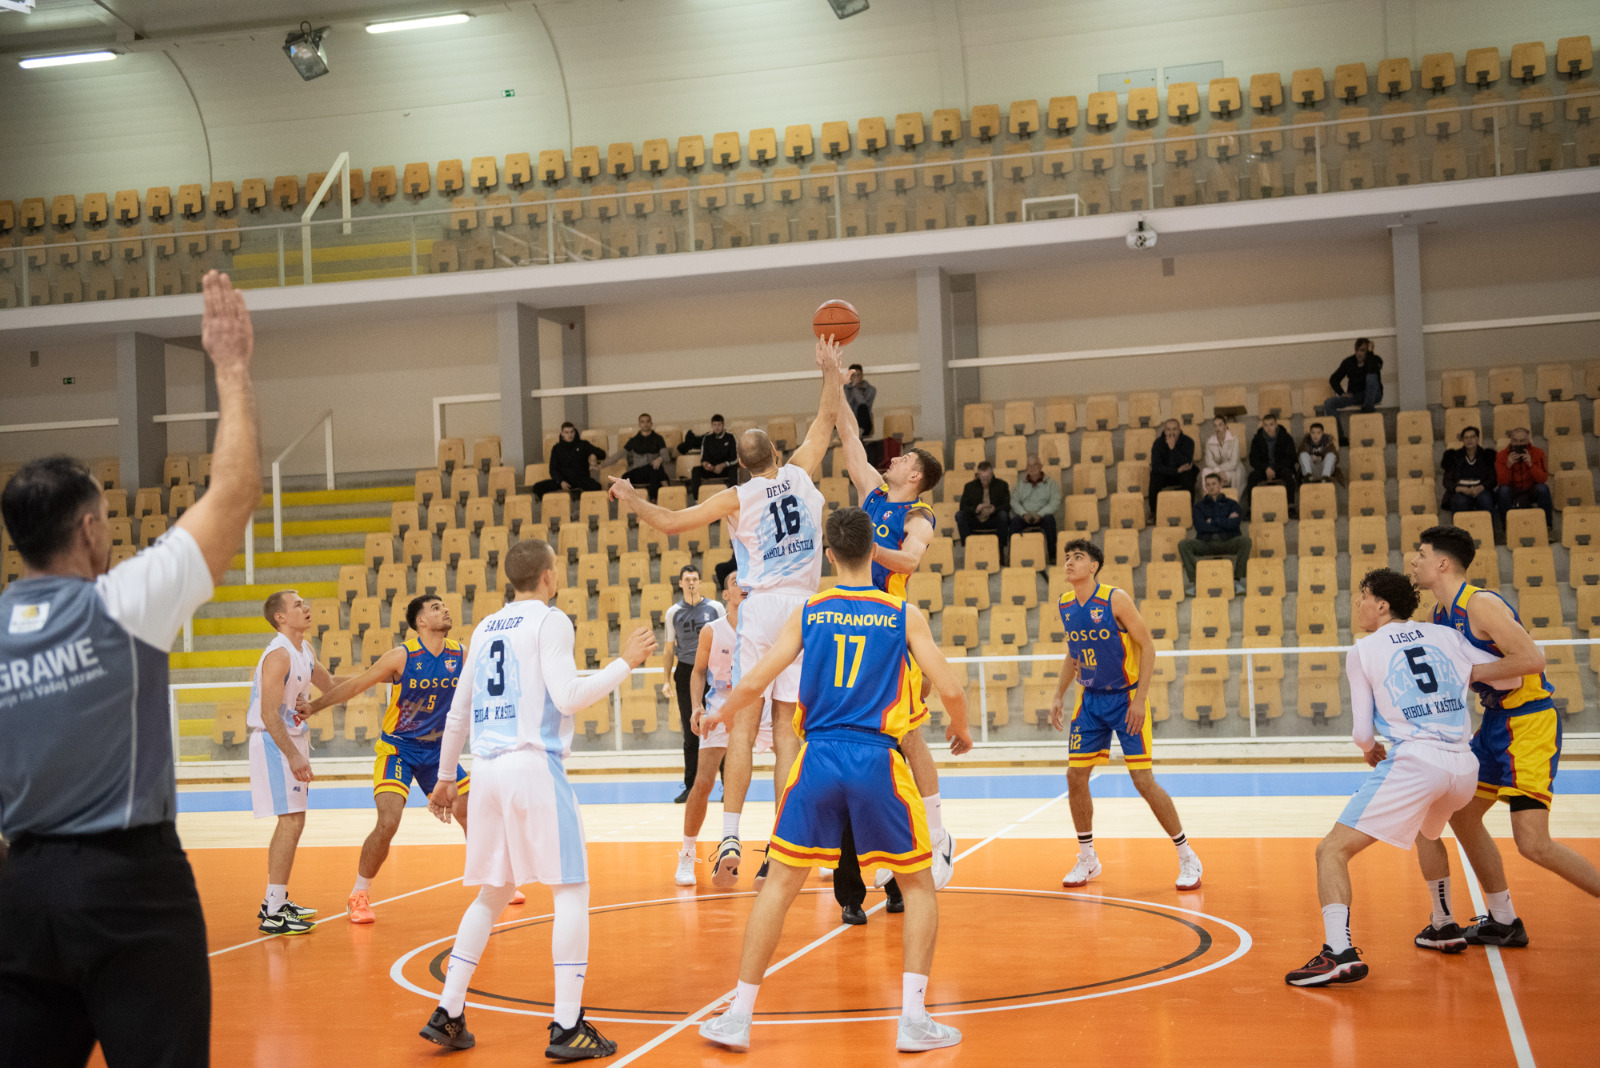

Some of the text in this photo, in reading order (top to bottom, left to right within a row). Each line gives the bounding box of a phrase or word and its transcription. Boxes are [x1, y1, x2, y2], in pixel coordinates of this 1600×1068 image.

[769, 494, 800, 544] 16
[807, 611, 898, 628] PETRANOVIĆ
[1066, 628, 1110, 641] BOSCO
[834, 634, 866, 688] 17
[1081, 648, 1097, 666] 12
[487, 639, 505, 697] 3
[1403, 646, 1438, 694] 5
[409, 677, 458, 690] BOSCO
[426, 694, 437, 711] 5
[1070, 734, 1082, 750] 12
[395, 764, 402, 780] 5
